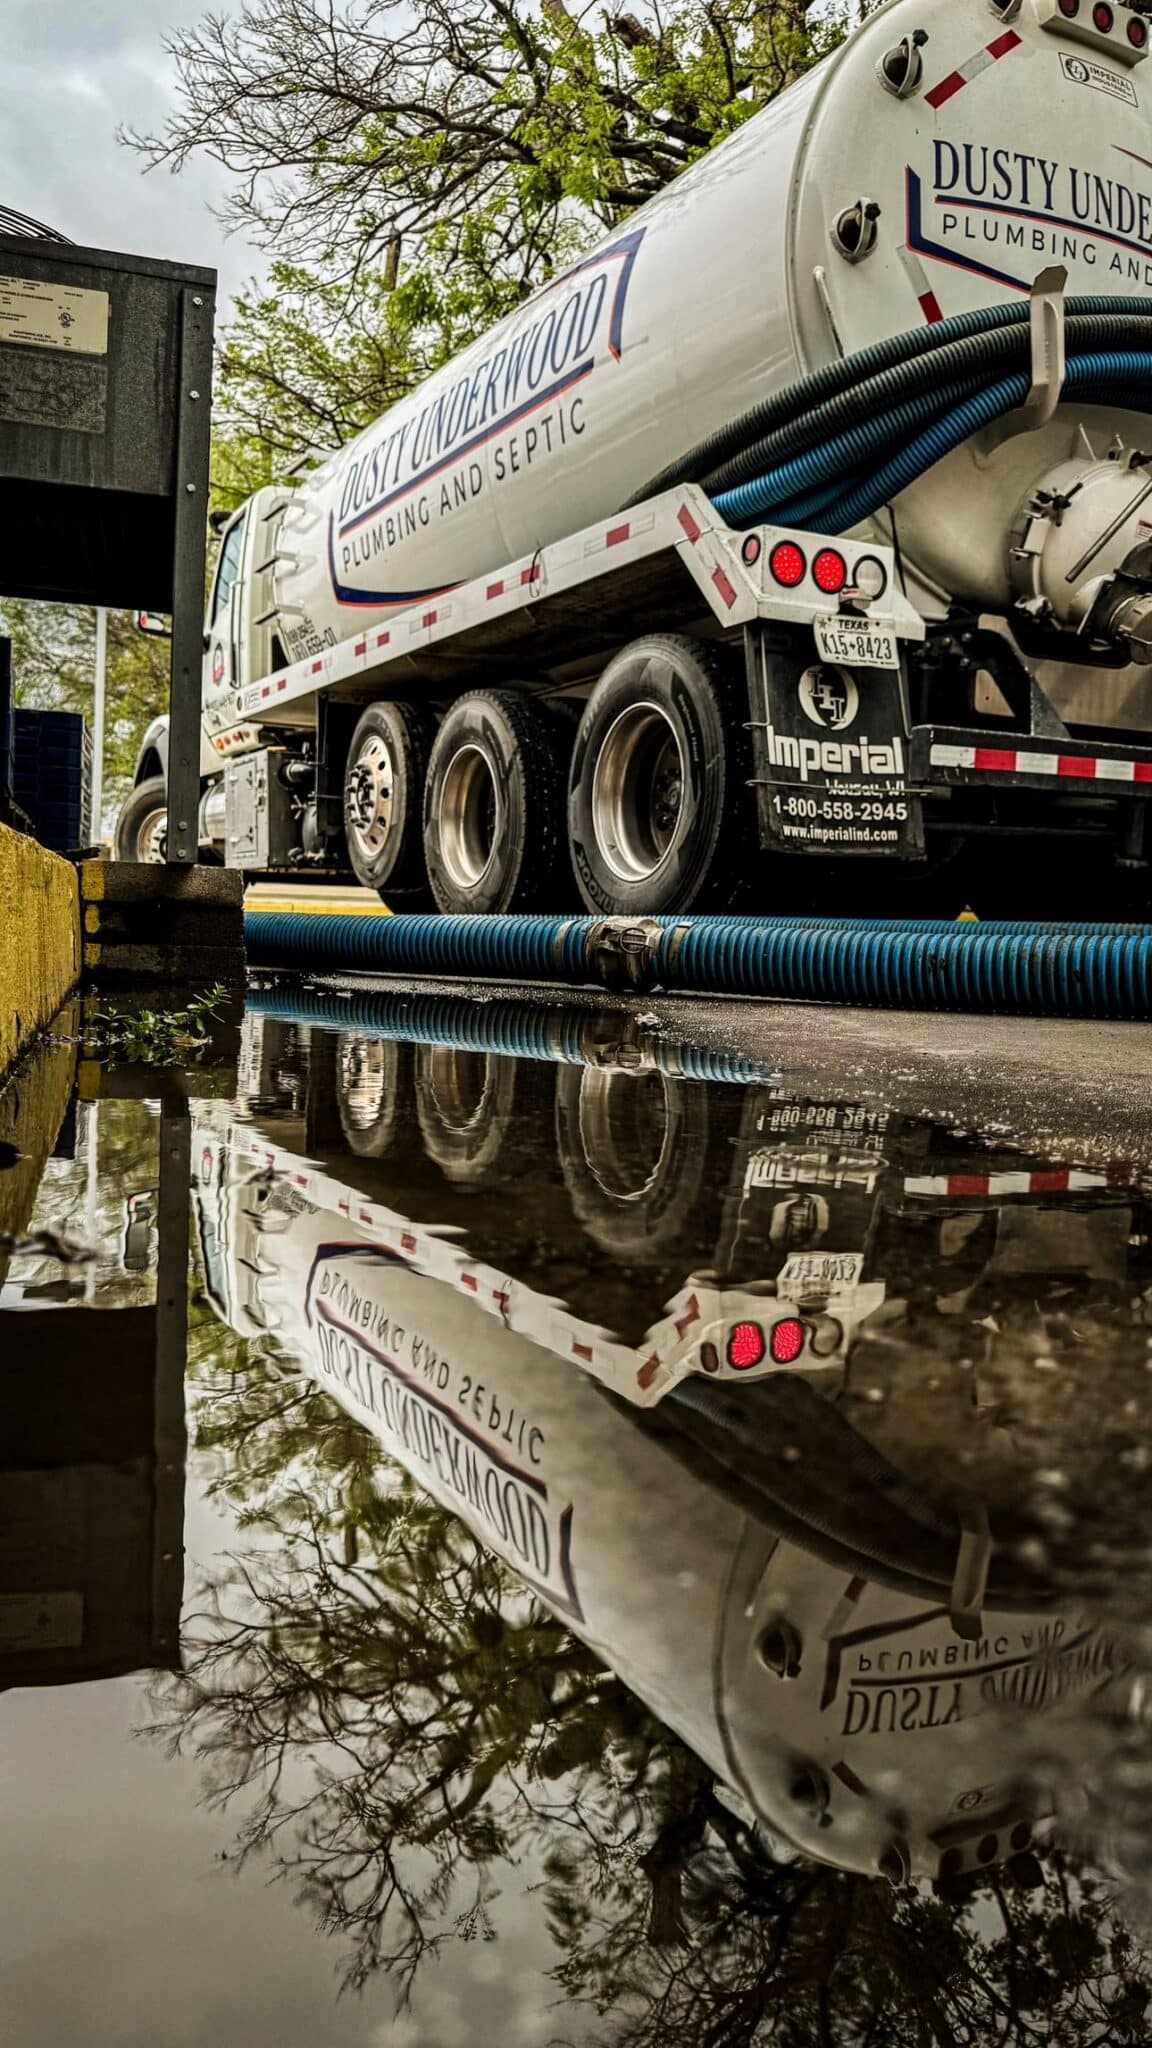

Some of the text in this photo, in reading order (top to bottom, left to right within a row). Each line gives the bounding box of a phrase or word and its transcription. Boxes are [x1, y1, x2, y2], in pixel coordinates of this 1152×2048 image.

[933, 139, 1152, 245] DUSTY UNDE
[942, 213, 1096, 264] PLUMBING
[338, 273, 608, 522] DUSTY UNDERWOOD
[342, 398, 586, 573] PLUMBING AND SEPTIC
[839, 619, 869, 631] TEXAS
[767, 725, 904, 782] Imperial
[773, 794, 908, 820] 1-800-558-2945
[782, 824, 899, 843] www.imperialind.com
